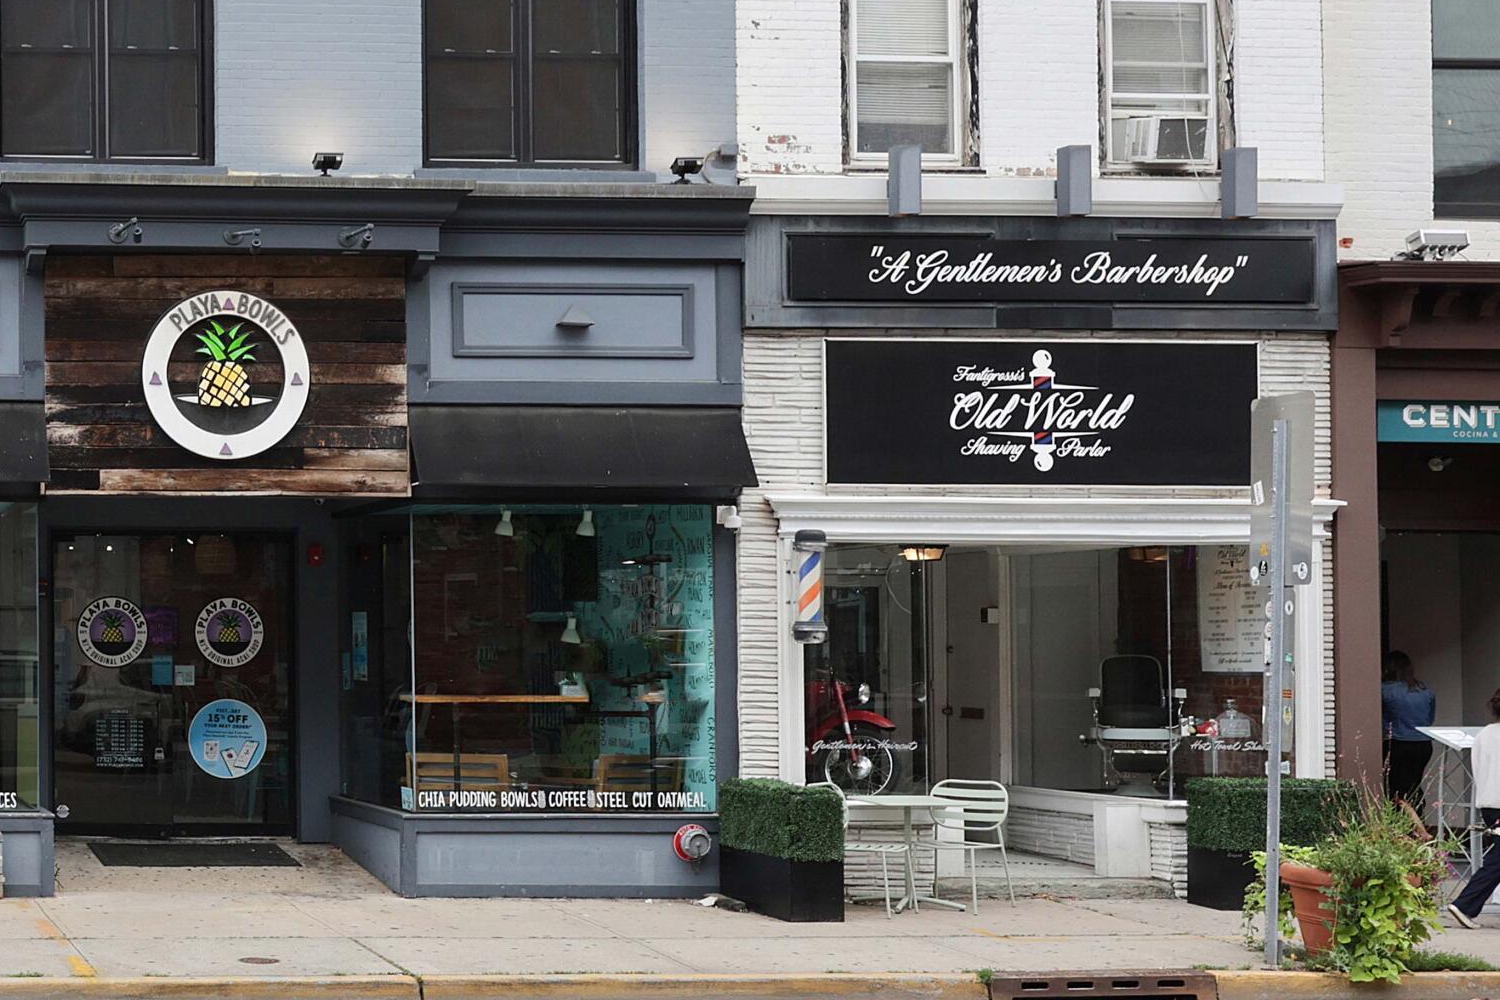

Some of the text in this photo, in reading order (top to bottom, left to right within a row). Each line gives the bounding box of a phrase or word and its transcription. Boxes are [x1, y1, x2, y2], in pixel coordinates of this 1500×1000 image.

[905, 250, 1062, 294] Gentlemen's
[1071, 251, 1248, 296] Barbershop"
[169, 293, 296, 345] PLAYA BOWLS
[950, 391, 1134, 430] Old World
[1453, 430, 1488, 438] COCINA
[961, 436, 1111, 462] Shaving Parlor
[80, 600, 109, 629] PLAYA
[114, 599, 145, 629] BOWLS
[198, 600, 227, 629] PLAYA
[231, 600, 262, 629] BOWLS
[90, 651, 117, 665] ORIGINAL
[208, 651, 235, 665] ORIGINAL
[227, 714, 248, 723] OFF
[707, 716, 717, 783] CRANFORD
[1190, 740, 1212, 751] Hot
[1214, 740, 1242, 751] Towel
[418, 791, 706, 808] CHIA PUDDING BOWLS COFFEE STEEL CUT OATMEAL
